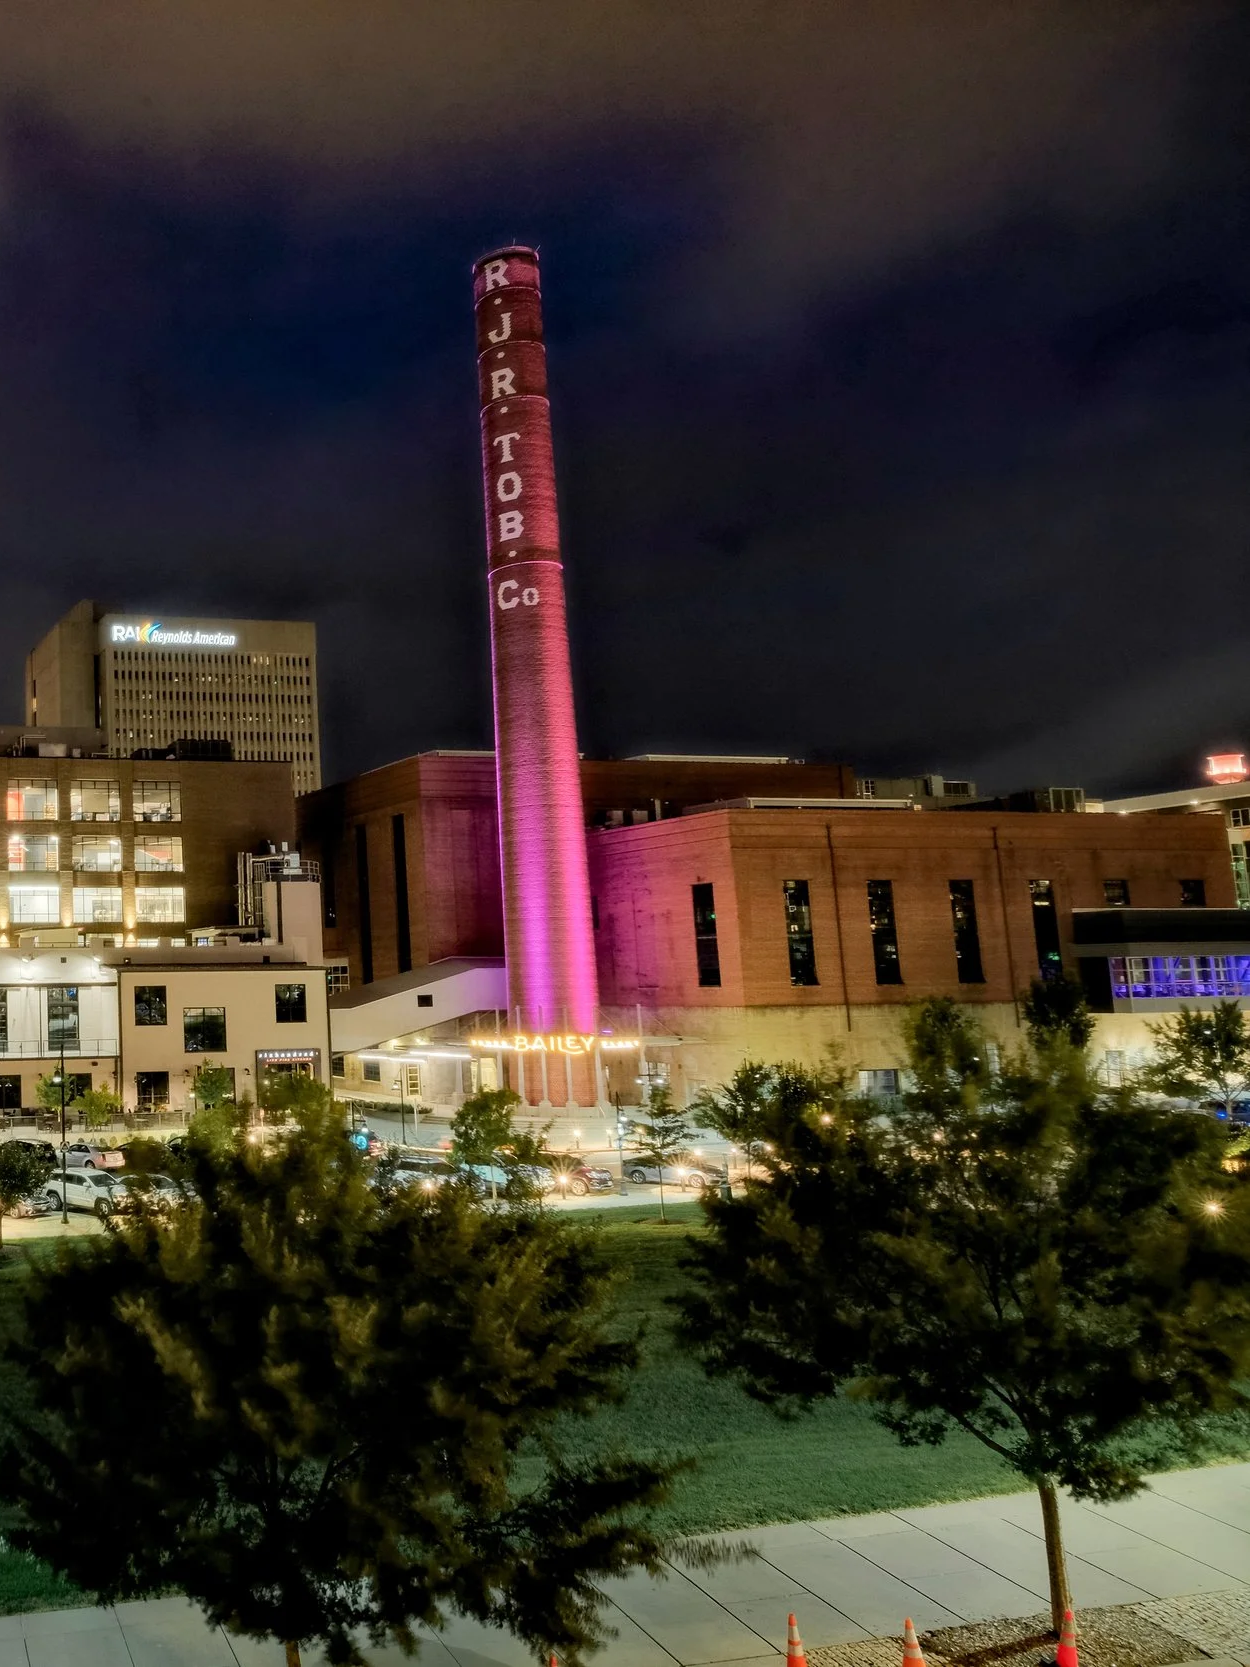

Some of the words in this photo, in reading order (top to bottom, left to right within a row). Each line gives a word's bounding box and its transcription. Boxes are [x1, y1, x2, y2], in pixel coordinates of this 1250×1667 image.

[151, 630, 193, 645] Reynolds
[193, 631, 236, 646] American
[513, 1035, 595, 1055] BAILEY
